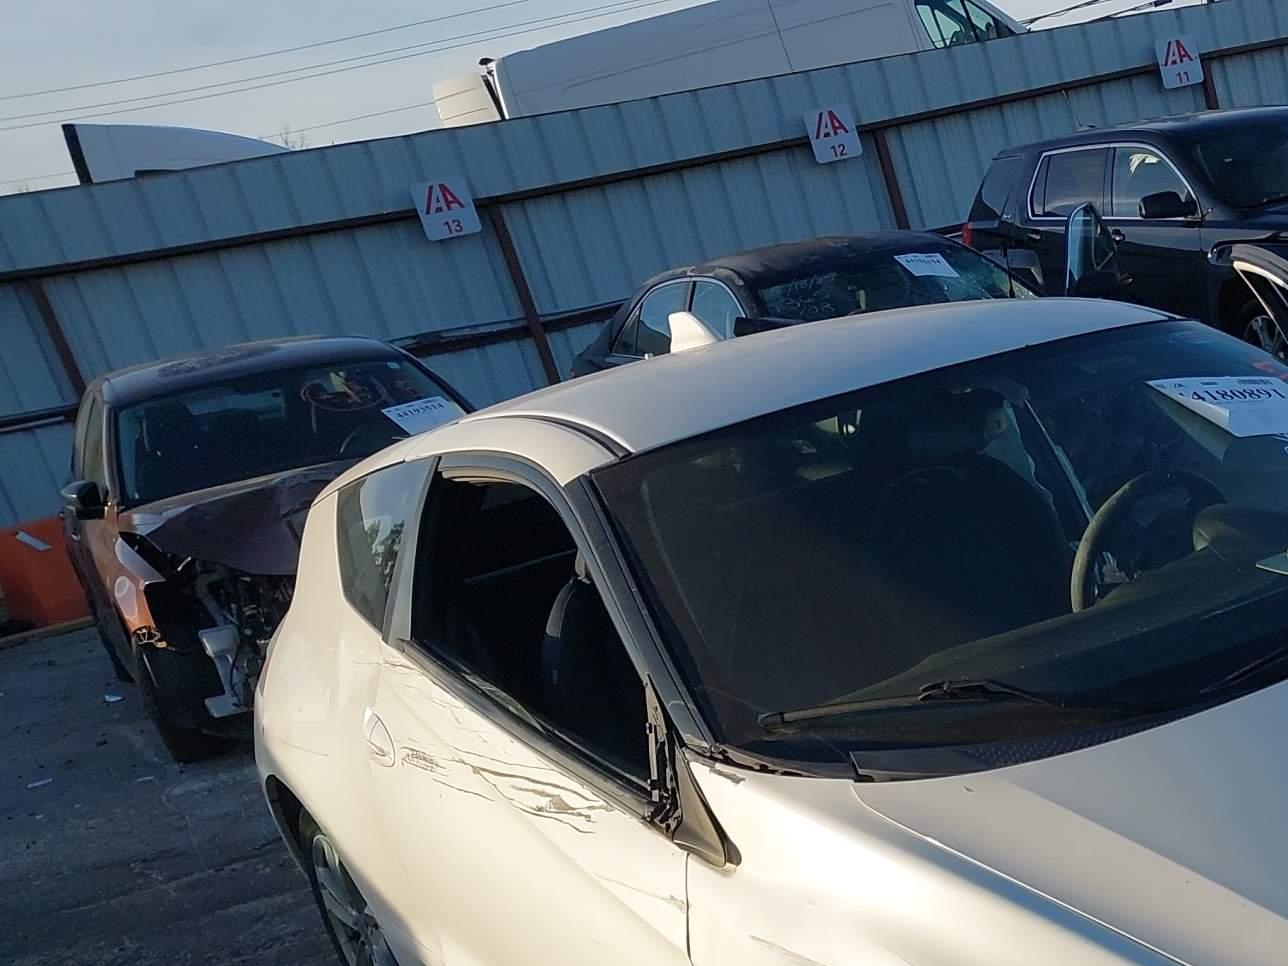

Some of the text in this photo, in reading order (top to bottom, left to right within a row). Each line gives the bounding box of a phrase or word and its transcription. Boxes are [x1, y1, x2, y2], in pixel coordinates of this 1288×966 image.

[1176, 71, 1190, 84] 11
[830, 143, 848, 158] 12
[443, 219, 464, 235] 13
[1179, 388, 1286, 402] 4180891
